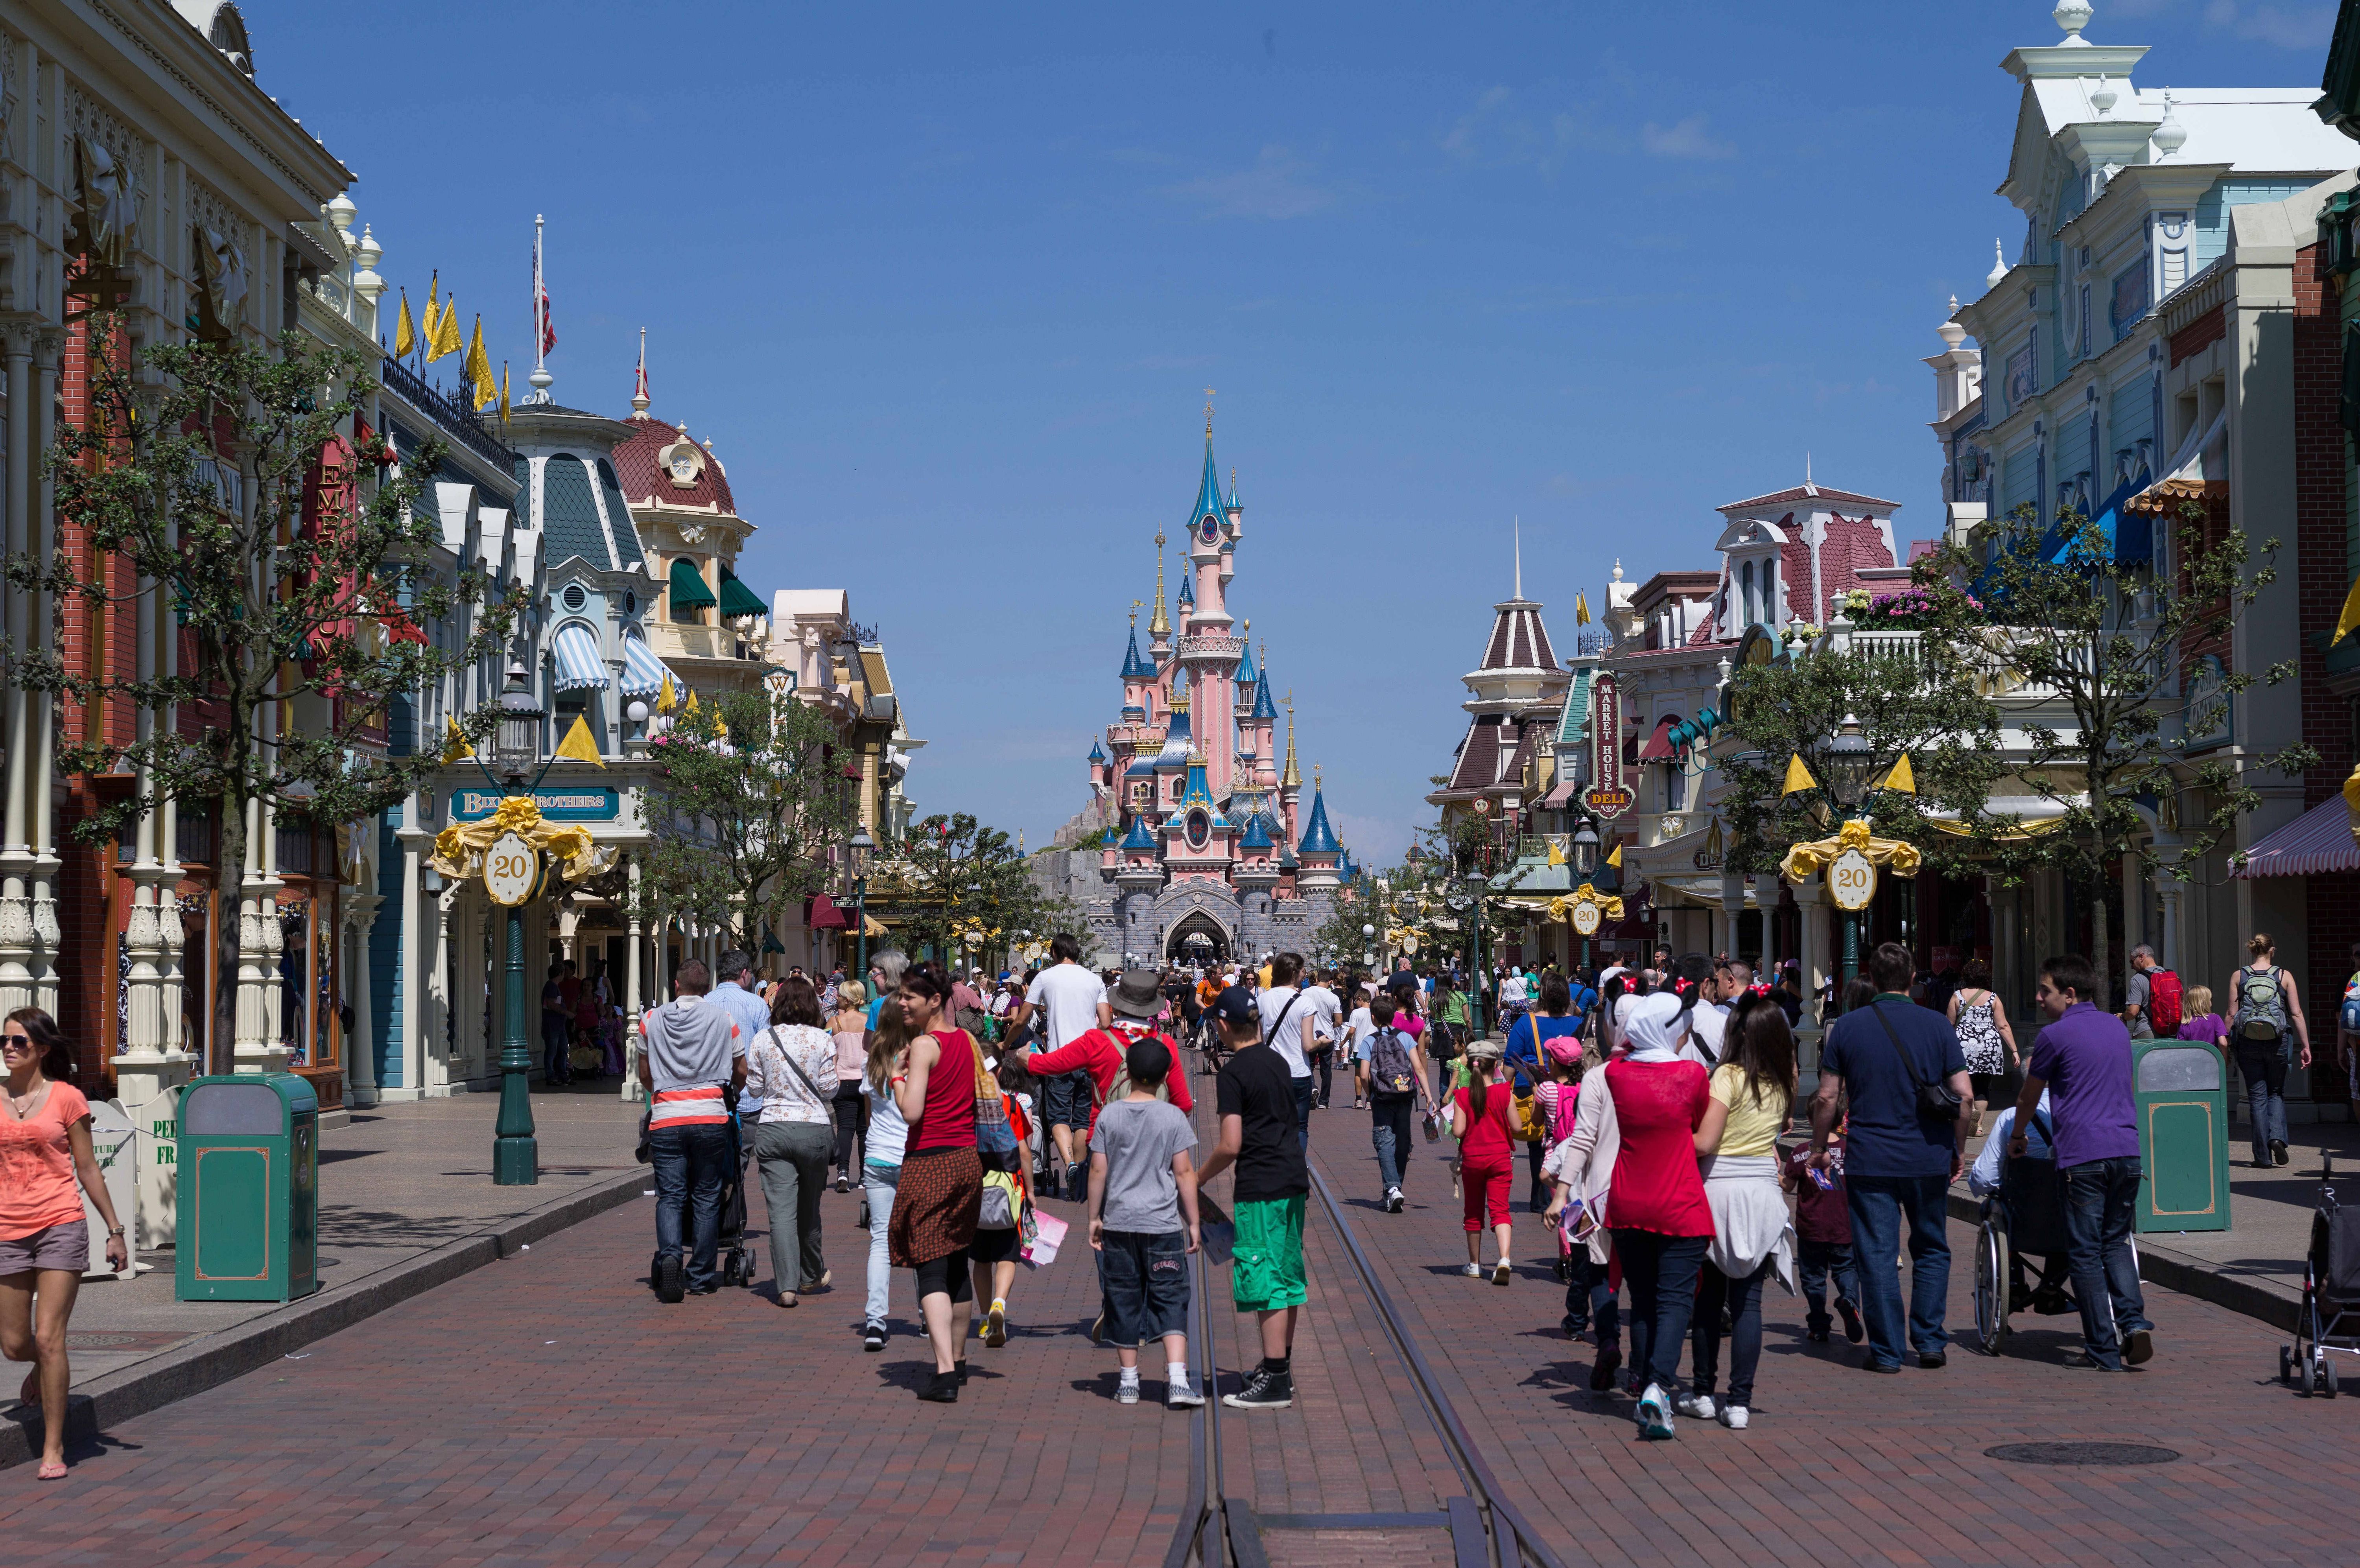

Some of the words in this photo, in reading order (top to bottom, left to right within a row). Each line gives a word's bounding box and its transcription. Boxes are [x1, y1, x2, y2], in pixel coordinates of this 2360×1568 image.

[1601, 685, 1612, 740] MARKET
[1602, 746, 1613, 791] HOUSE
[463, 793, 504, 813] BIX
[1592, 794, 1625, 804] DELI
[494, 855, 527, 878] 20
[1838, 869, 1867, 888] 20
[1578, 910, 1595, 922] 20
[153, 1120, 177, 1138] PEI
[93, 1144, 119, 1154] TURE
[157, 1146, 177, 1164] FR
